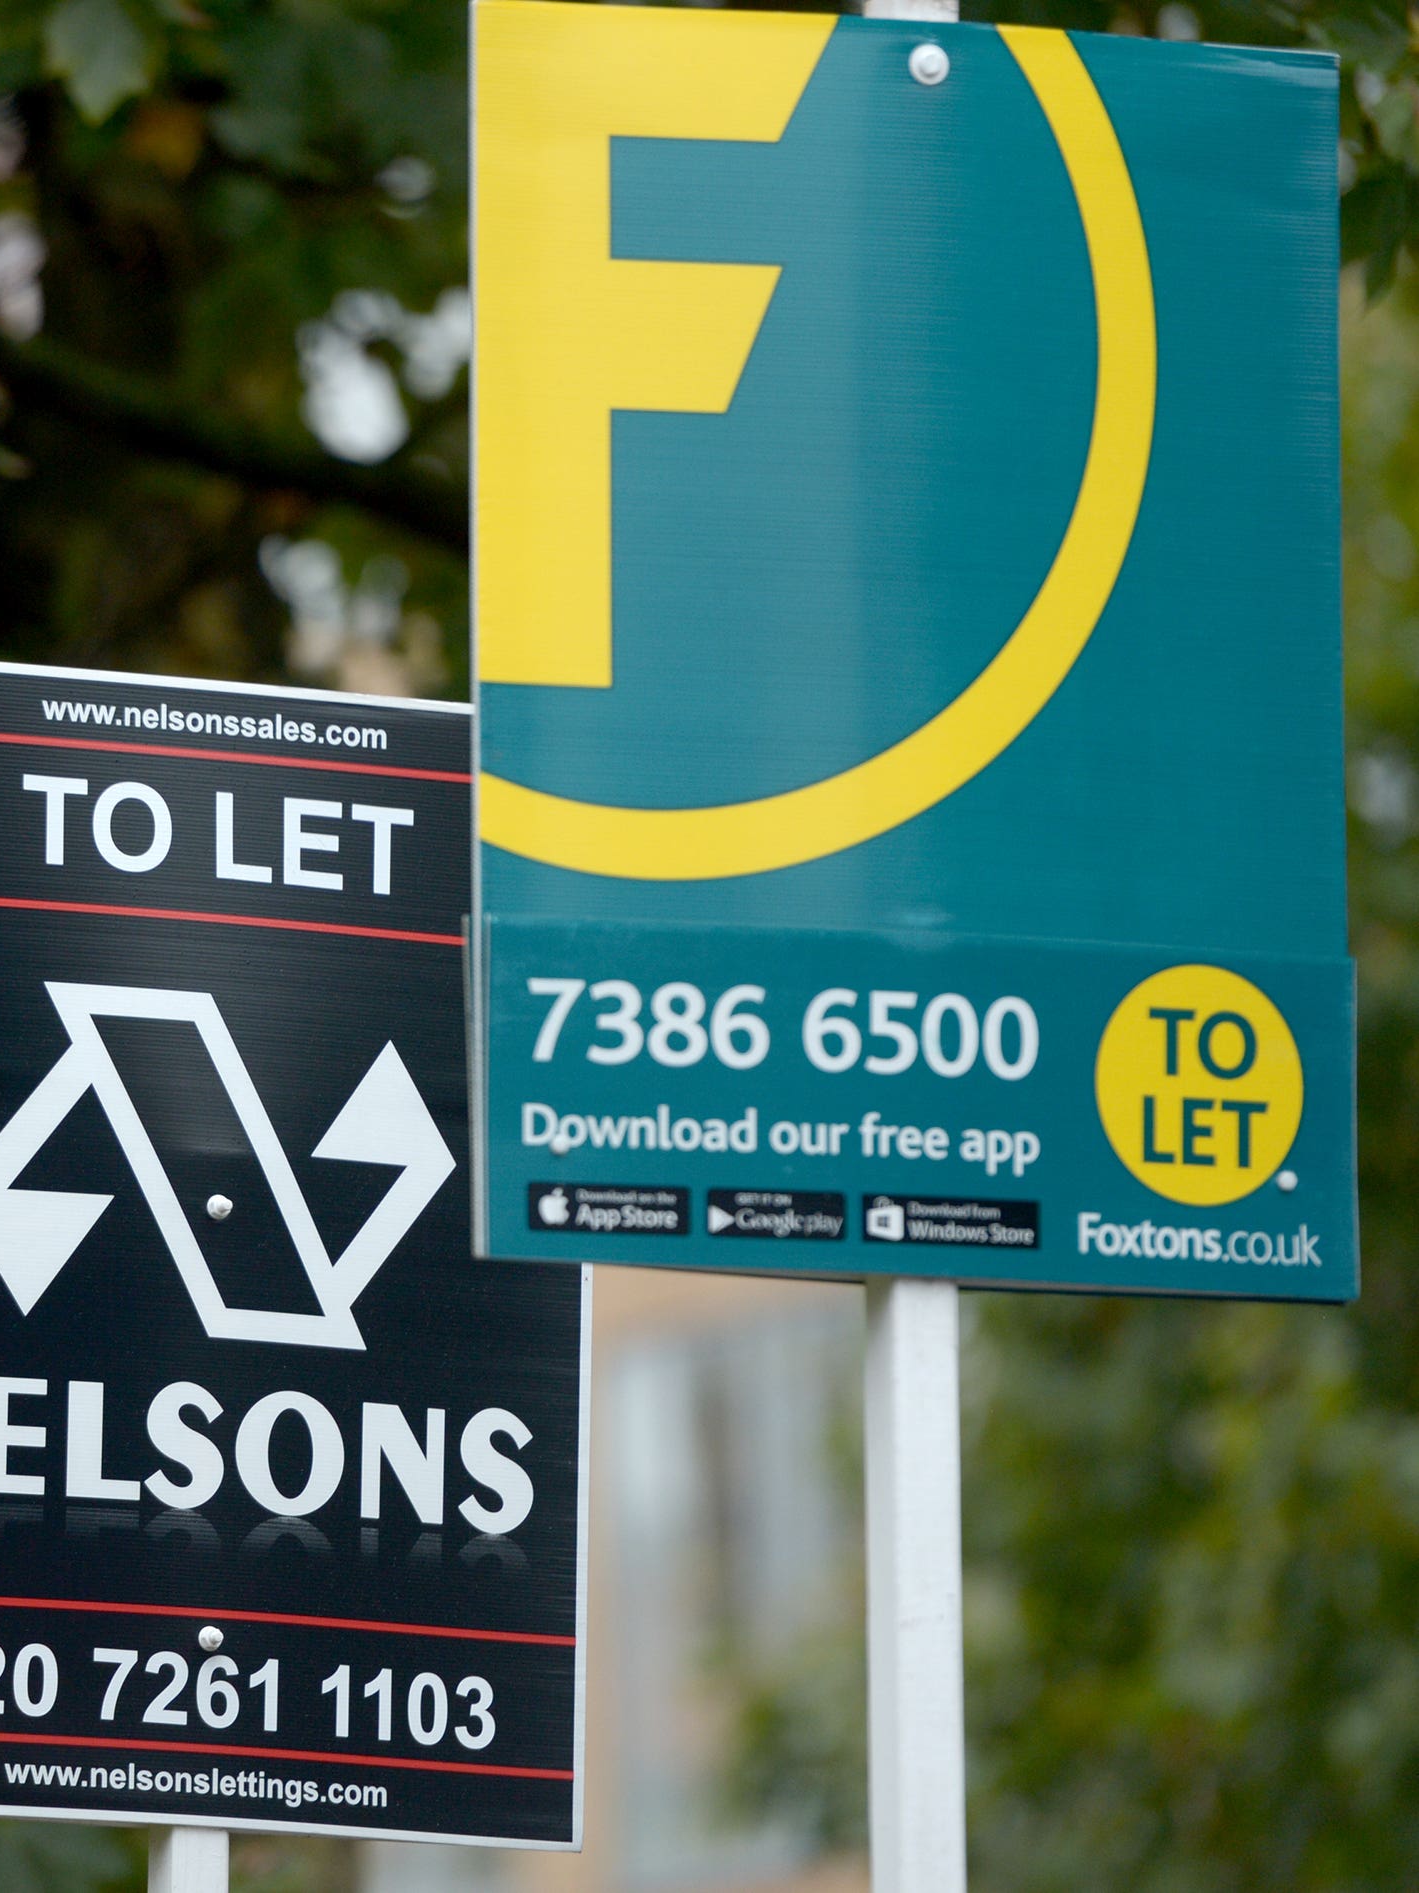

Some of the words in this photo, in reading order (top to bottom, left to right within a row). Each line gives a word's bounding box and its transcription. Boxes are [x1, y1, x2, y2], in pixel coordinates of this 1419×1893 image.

[42, 699, 389, 750] www.nelsonssales.com
[22, 773, 173, 874] TO
[215, 791, 415, 896] LET
[526, 976, 771, 1070] 7386
[801, 987, 1041, 1081] 6500
[1148, 1007, 1259, 1081] TO
[521, 1102, 758, 1153] Download
[768, 1121, 850, 1156] our
[858, 1112, 948, 1161] free
[959, 1127, 1041, 1176] app
[1142, 1095, 1270, 1169] LET
[575, 1203, 621, 1232] App
[621, 1204, 679, 1230] Store
[734, 1207, 803, 1237] Google
[803, 1211, 844, 1237] play
[907, 1201, 970, 1218] Download
[971, 1204, 1001, 1220] from
[907, 1220, 988, 1242] Windows
[988, 1223, 1035, 1245] Store
[1077, 1212, 1323, 1268] Foxtons.co.uk
[93, 1647, 279, 1732] 7261
[321, 1663, 495, 1750] 1103
[4, 1759, 388, 1808] www.nelsonslettings.com
